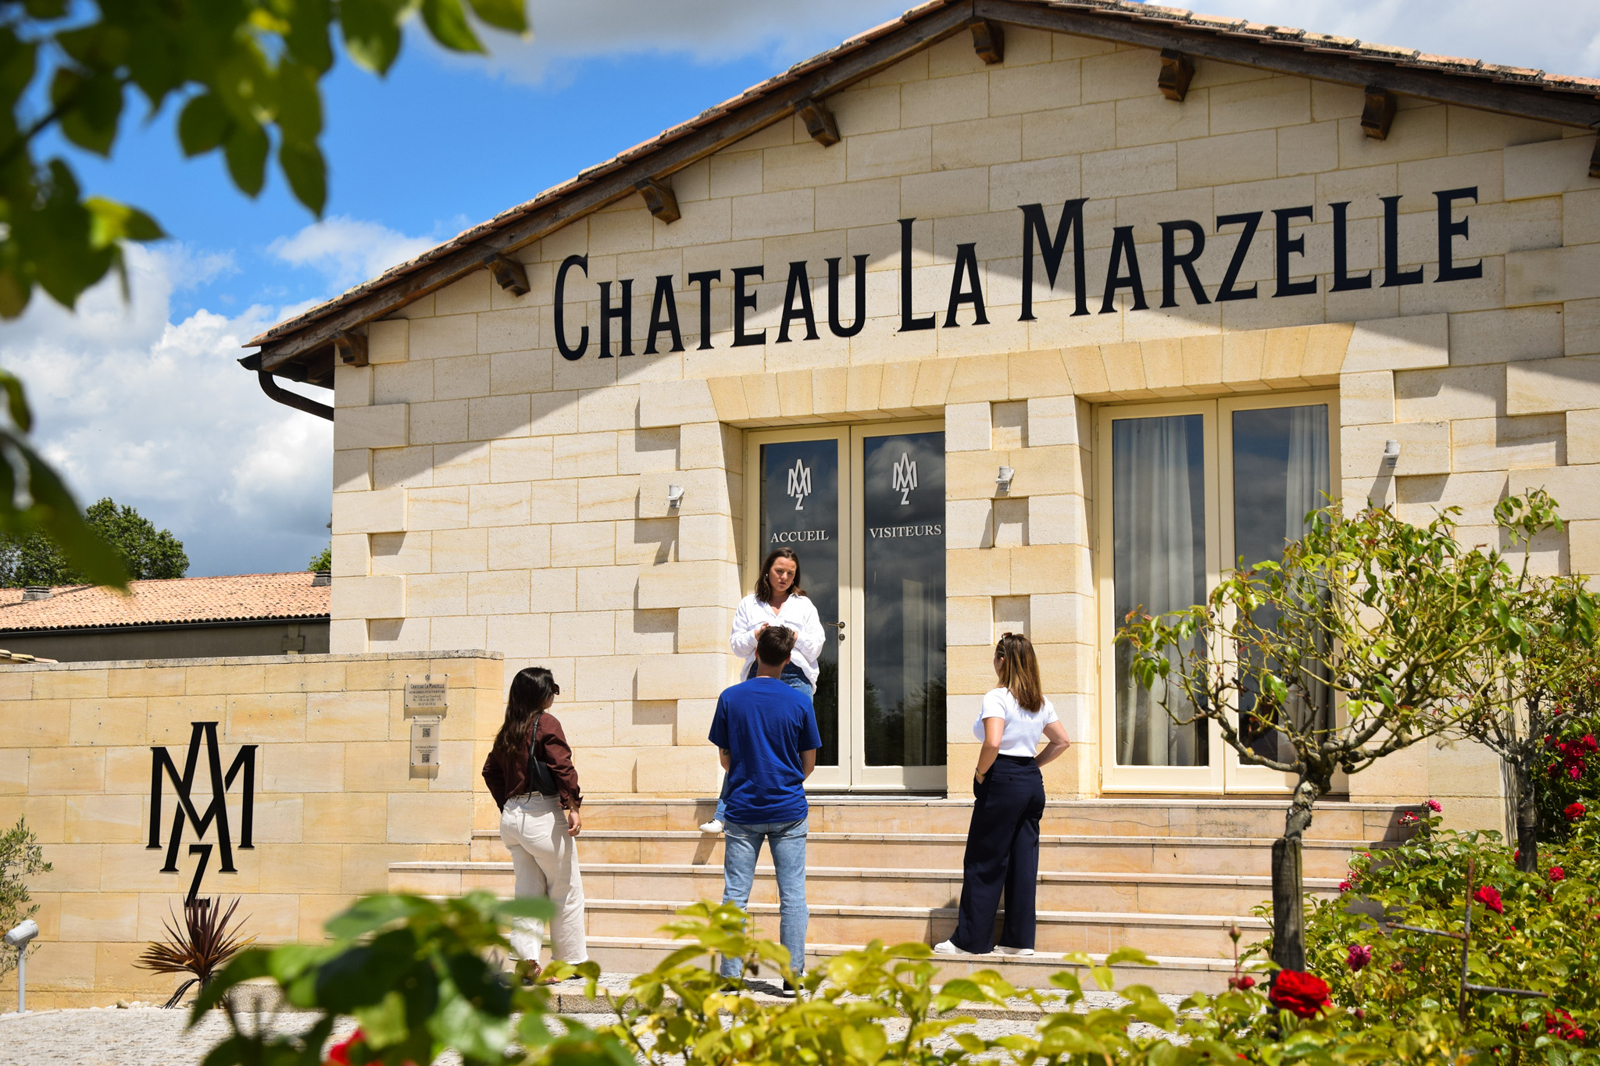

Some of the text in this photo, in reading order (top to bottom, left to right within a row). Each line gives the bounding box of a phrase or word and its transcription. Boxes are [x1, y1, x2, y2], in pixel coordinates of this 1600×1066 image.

[554, 185, 1483, 362] CHATEAU LA MARZELLE
[770, 530, 830, 543] ACCUEIL
[869, 524, 942, 539] VISITEURS
